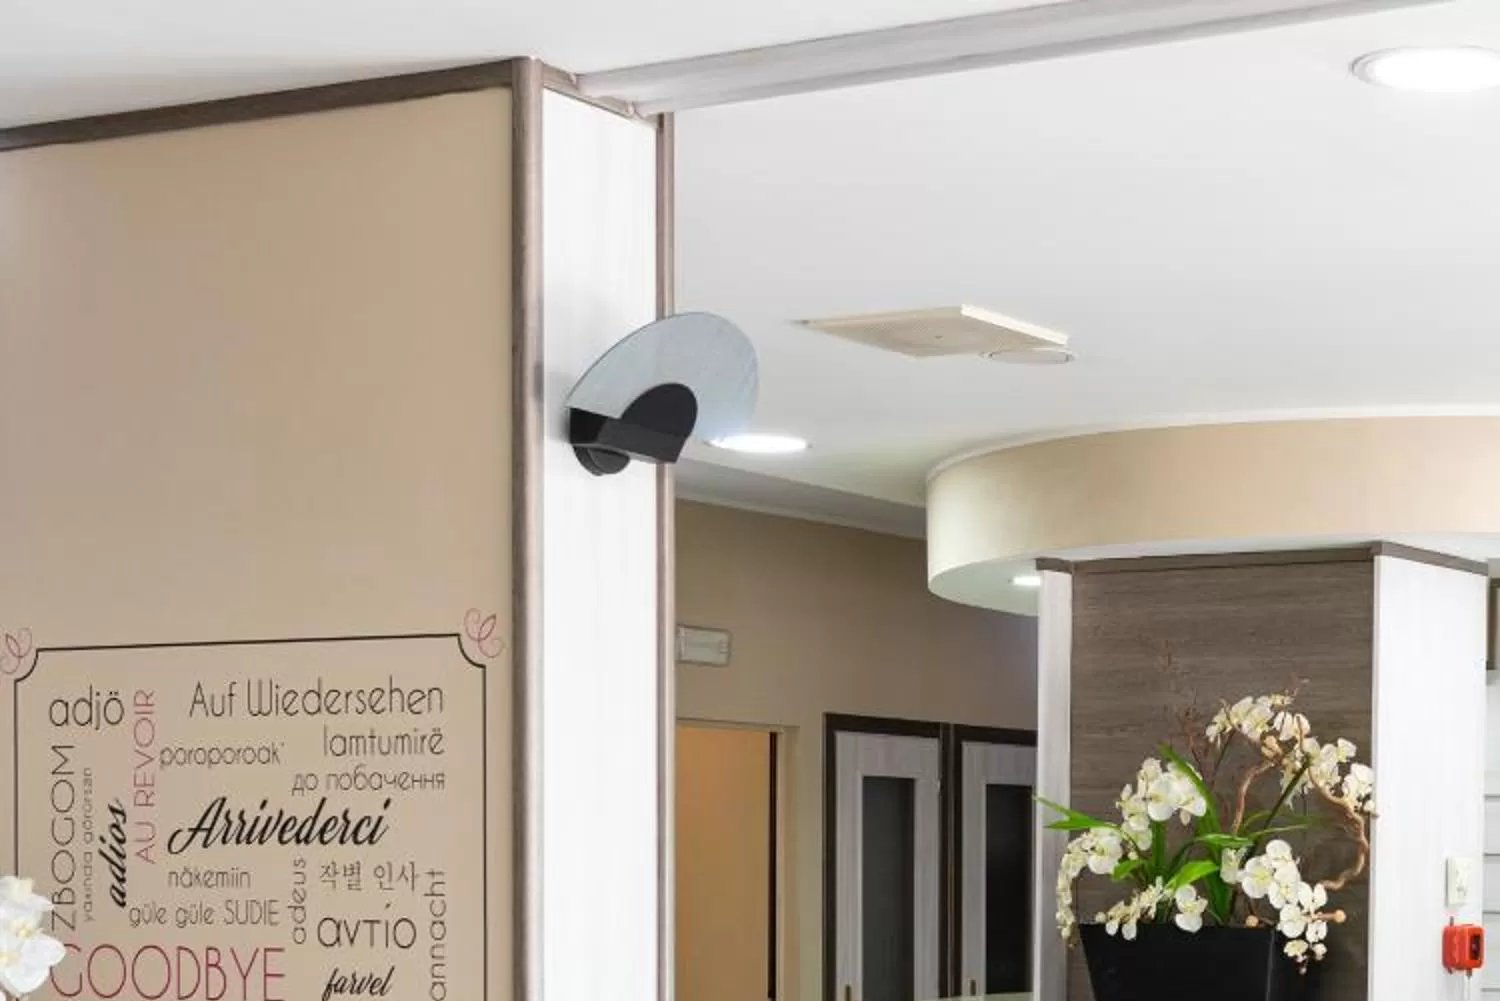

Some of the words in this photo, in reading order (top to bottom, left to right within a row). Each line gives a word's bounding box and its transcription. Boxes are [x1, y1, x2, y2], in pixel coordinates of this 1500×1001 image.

[49, 684, 125, 731] adjö
[188, 680, 237, 718] Auf
[247, 675, 444, 717] Wiedersehen
[133, 688, 156, 807] REVOIR
[322, 724, 446, 757] lamtumirë
[291, 772, 319, 797] до
[326, 762, 446, 792] побачення
[50, 744, 77, 932] ZBOGOM
[134, 820, 157, 864] AU
[167, 796, 392, 856] Arrivederci
[98, 797, 128, 909] adios
[319, 860, 363, 892] 작별
[373, 860, 421, 893] 인사
[175, 900, 216, 929] güle
[223, 898, 280, 927] SUDIE
[288, 858, 307, 945] adeus
